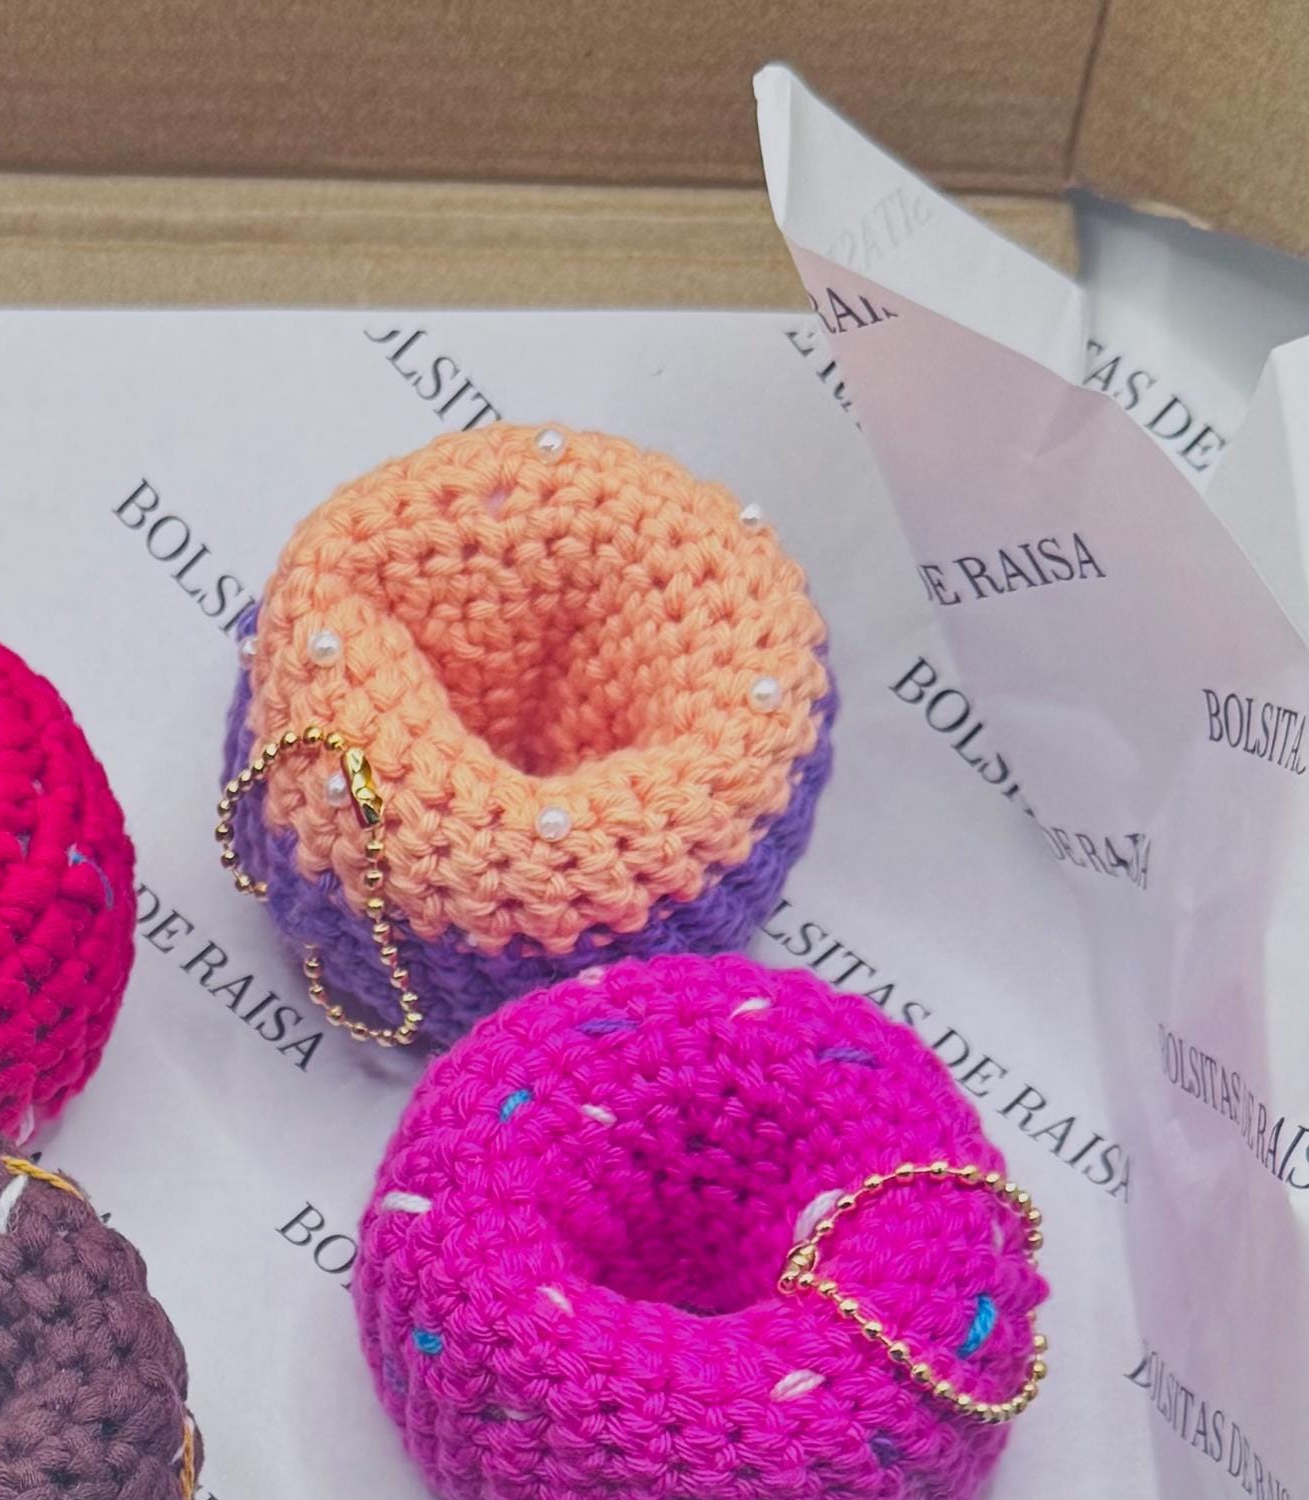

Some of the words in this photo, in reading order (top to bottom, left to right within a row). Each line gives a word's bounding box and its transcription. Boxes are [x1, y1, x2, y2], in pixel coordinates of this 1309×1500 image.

[1144, 394, 1227, 473] DE
[952, 532, 1107, 600] RAISA
[179, 940, 324, 1072] RAISA
[929, 1026, 1009, 1099] DE
